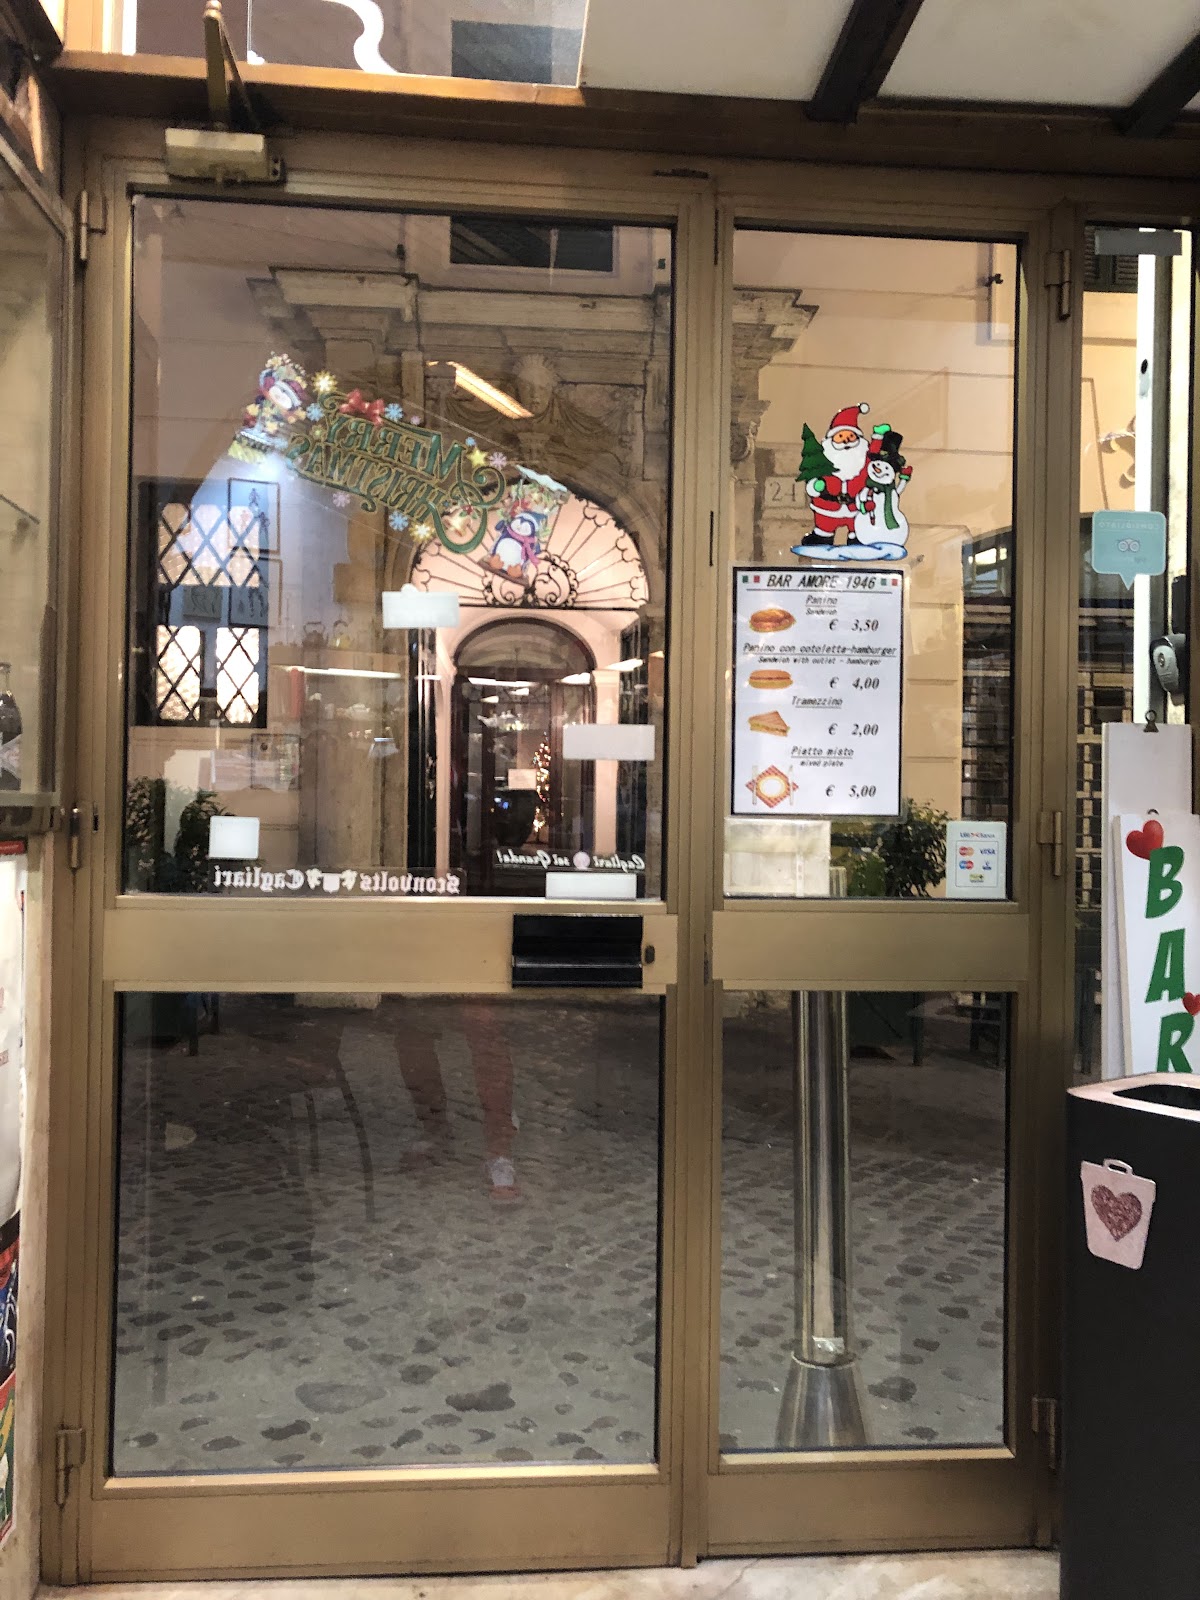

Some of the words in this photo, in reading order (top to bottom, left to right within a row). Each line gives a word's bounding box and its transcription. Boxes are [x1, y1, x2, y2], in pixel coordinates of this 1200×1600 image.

[767, 574, 792, 588] BAR
[797, 575, 839, 589] AMORE
[845, 576, 876, 590] 1946
[805, 594, 838, 605] Panino
[829, 618, 839, 631] €
[851, 619, 879, 632] 3,50
[743, 642, 776, 653] Panino
[779, 645, 796, 653] con
[758, 656, 790, 664] Sandwich
[793, 656, 810, 664] with
[846, 658, 881, 666] hamburger
[829, 677, 839, 689] €
[852, 677, 880, 690] 4,00
[791, 696, 843, 706] Tramezzino
[828, 723, 838, 736] €
[851, 723, 879, 737] 2,00
[791, 745, 823, 756] Piatto
[826, 747, 854, 757] misto
[825, 784, 836, 797] €
[849, 785, 877, 798] 5,00
[979, 848, 996, 856] VISA
[1144, 845, 1195, 1074] BAR
